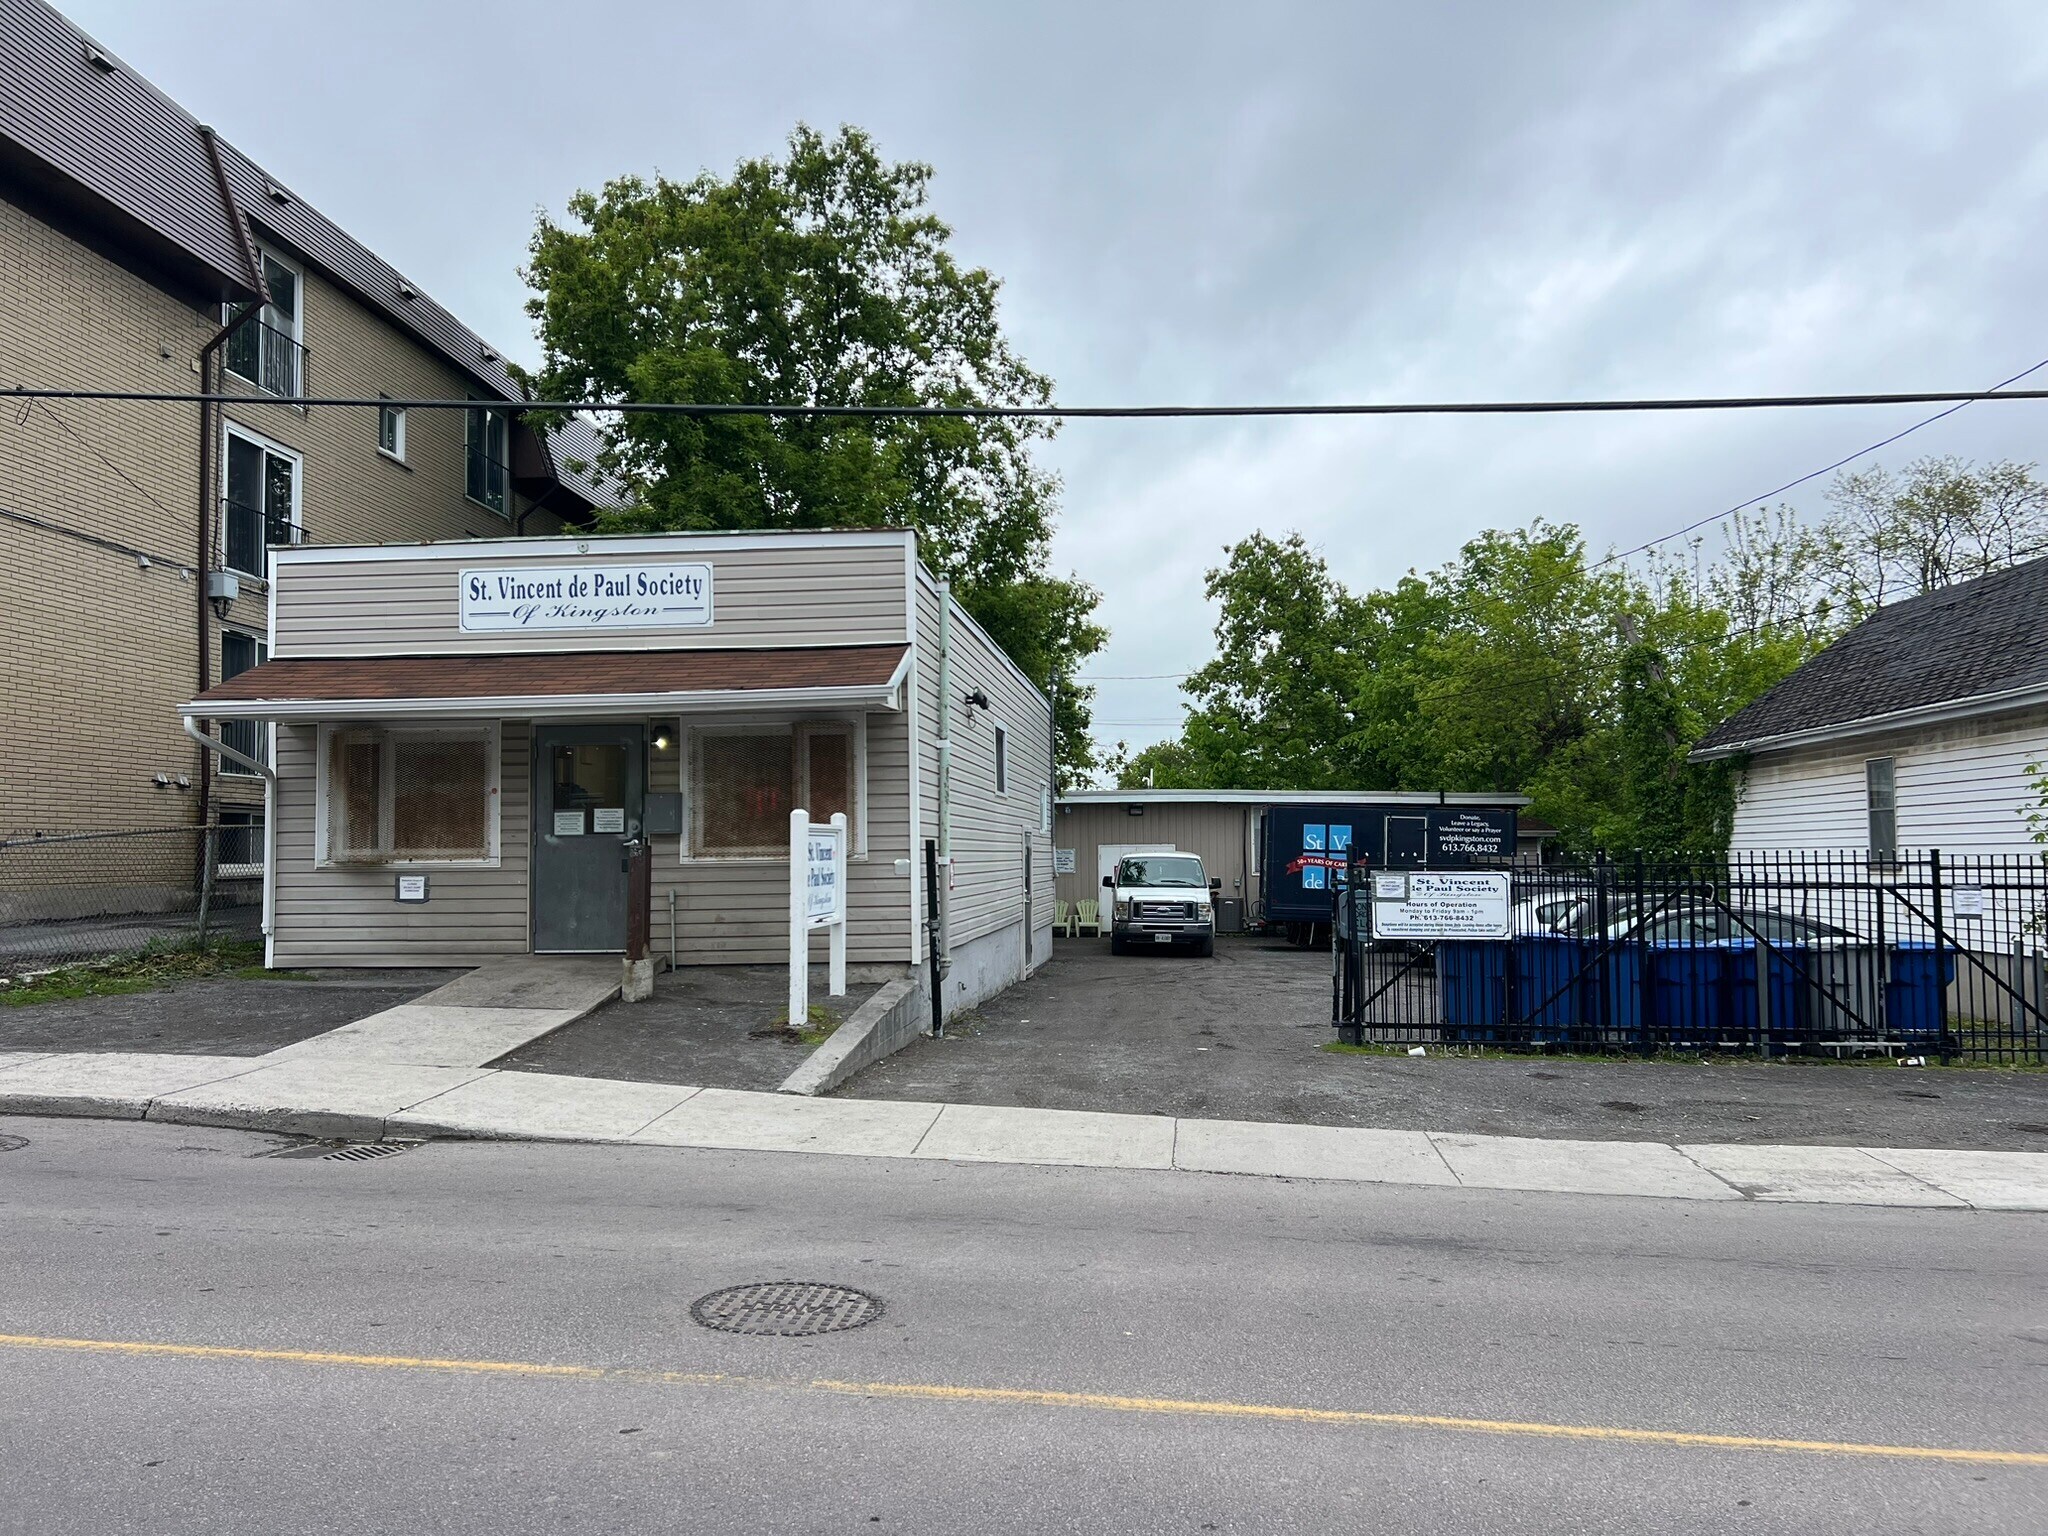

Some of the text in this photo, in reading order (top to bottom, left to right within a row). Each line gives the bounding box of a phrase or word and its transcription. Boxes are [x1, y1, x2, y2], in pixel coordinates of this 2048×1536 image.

[469, 572, 702, 600] St. Vincent de Paul Society
[513, 602, 659, 624] Of Kingston
[1305, 834, 1323, 850] St
[1439, 834, 1501, 843] svdpkingston.com
[816, 842, 832, 861] Vincent
[1442, 844, 1498, 853] 613.766.8432
[811, 867, 820, 887] Paul
[1304, 873, 1323, 889] de
[1456, 885, 1499, 893] Society
